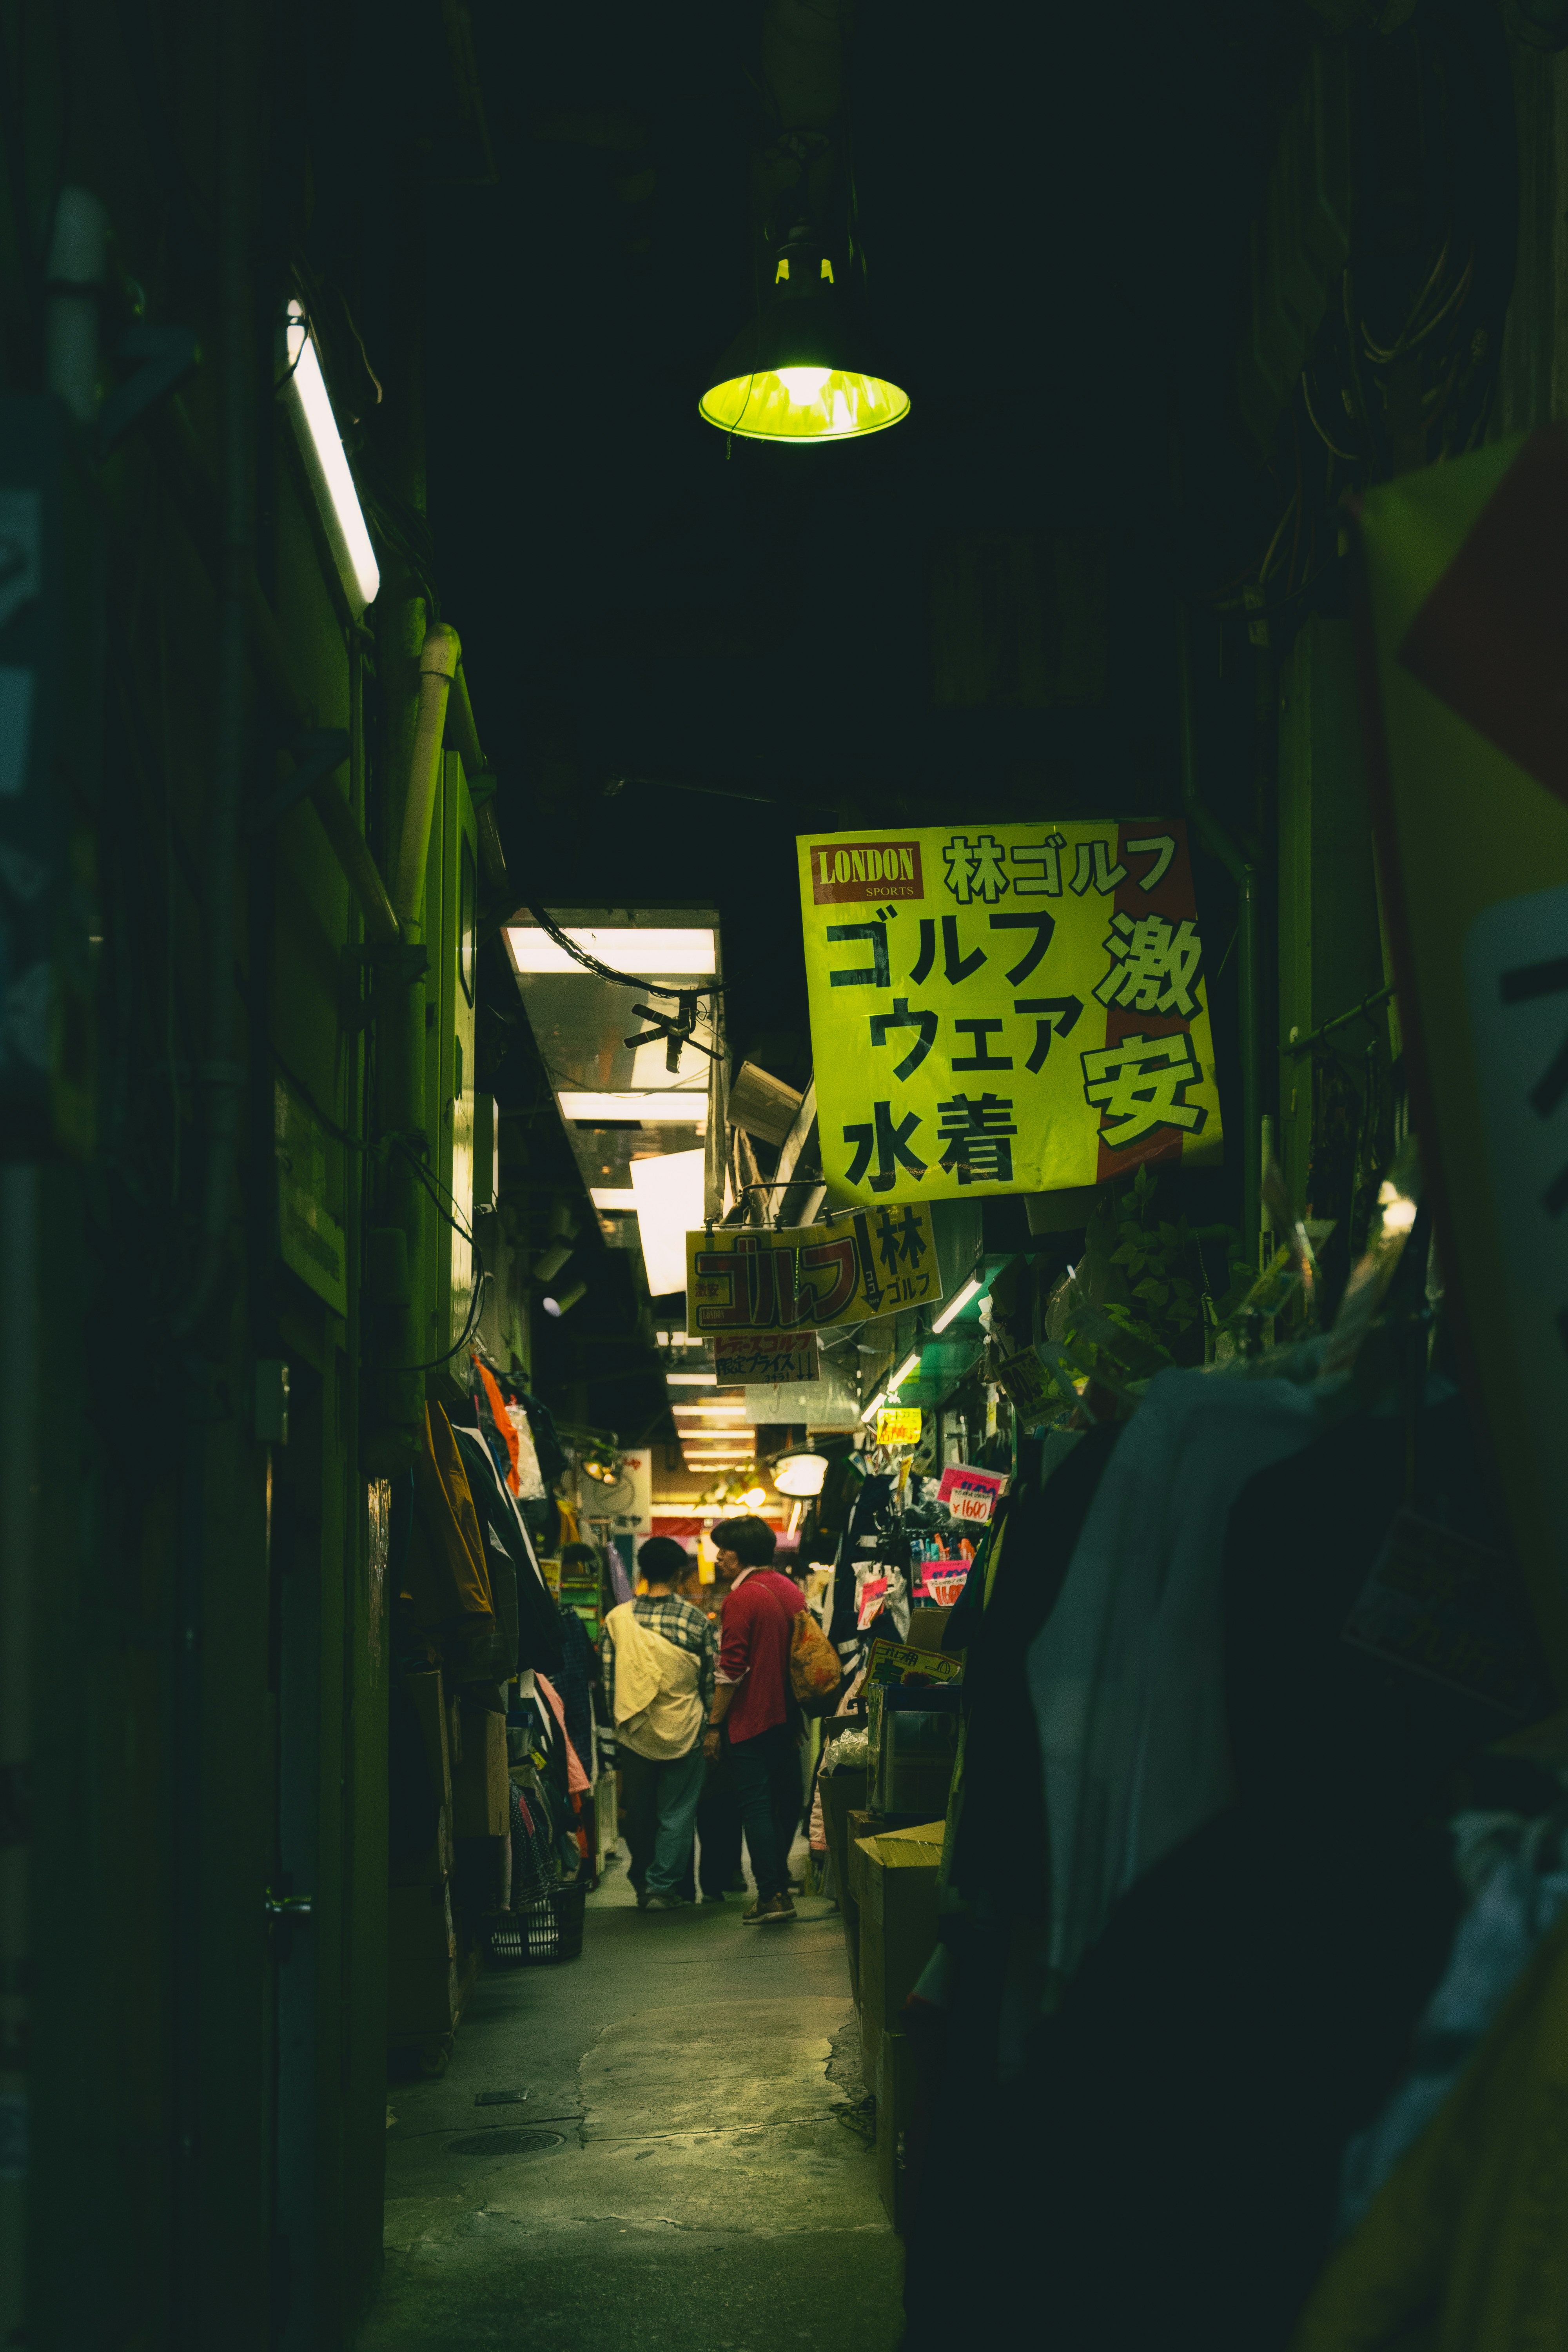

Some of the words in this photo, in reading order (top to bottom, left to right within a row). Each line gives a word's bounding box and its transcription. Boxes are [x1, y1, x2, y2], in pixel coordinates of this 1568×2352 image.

[818, 848, 914, 884] LONDON
[866, 887, 914, 897] SPORTS
[942, 831, 1179, 905] 林ゴルフ
[826, 904, 1055, 987] ゴルフ
[869, 994, 1084, 1082] ウェア
[1080, 912, 1209, 1151] 激安
[843, 1092, 1018, 1192] 水着
[876, 1206, 927, 1276] 林
[695, 1235, 860, 1330] ゴルフ
[702, 1309, 725, 1319] LONDON
[887, 1273, 929, 1304] ゴルフ
[715, 1352, 795, 1376] 限定プライス
[875, 1646, 918, 1667] ゴルフ用
